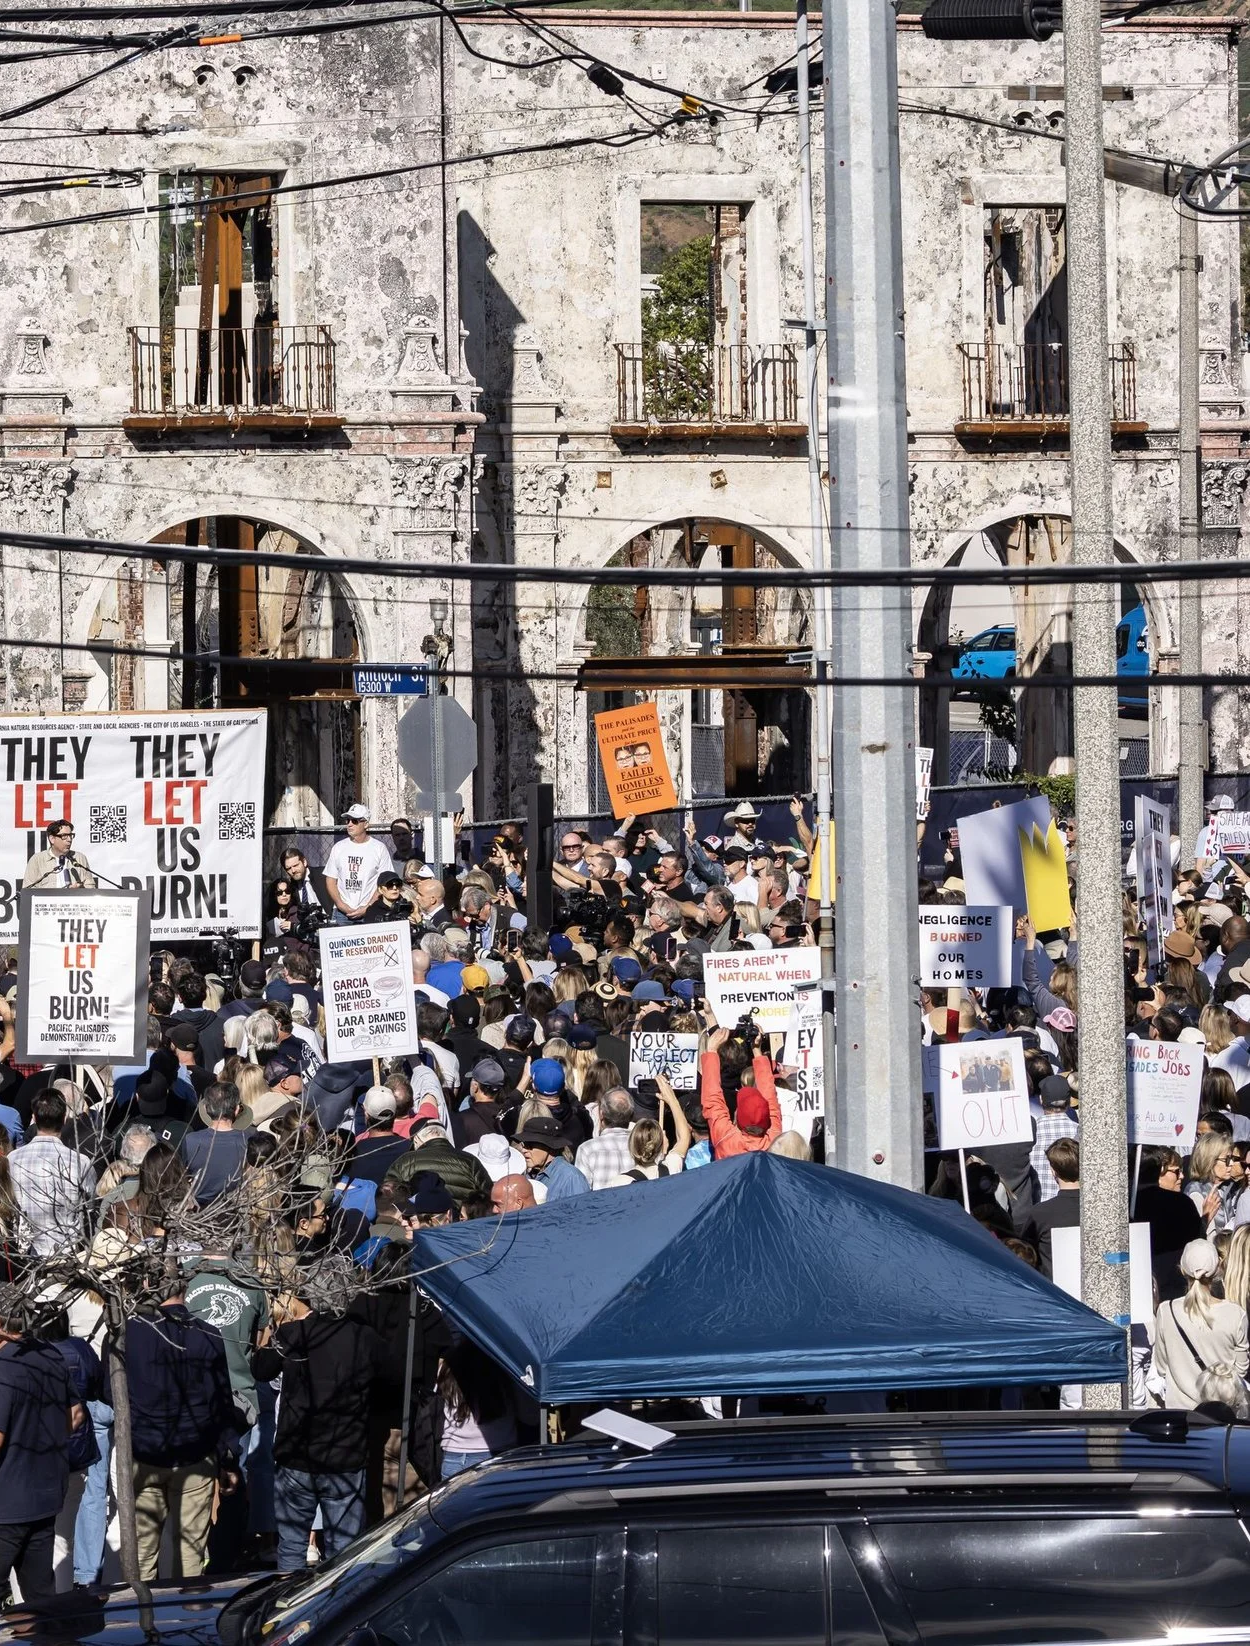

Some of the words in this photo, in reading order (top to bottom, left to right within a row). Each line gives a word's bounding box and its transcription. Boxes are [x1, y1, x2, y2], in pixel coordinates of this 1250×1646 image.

[358, 682, 382, 692] 15300
[384, 682, 392, 692] W
[600, 722, 614, 730] THE
[615, 714, 655, 728] PALISADES
[602, 732, 636, 744] ULTIMATE
[638, 727, 657, 737] PRICE
[0, 736, 92, 782] THEY
[130, 733, 220, 778] THEY
[620, 766, 654, 780] FAILED
[616, 776, 664, 792] HOMELESS
[624, 788, 661, 801] SCHEME
[14, 783, 78, 828] LET
[144, 780, 208, 825] LET
[1149, 809, 1163, 834] THEY
[1220, 812, 1240, 826] STATE
[1220, 831, 1246, 846] FAILED
[157, 826, 200, 872] US
[348, 856, 363, 864] THEY
[346, 879, 362, 888] BURN!
[918, 916, 992, 926] NEGLIGENCE
[58, 919, 107, 943] THEY
[930, 932, 982, 942] BURNED
[329, 938, 365, 949] QUIÑONES
[367, 934, 398, 944] DRAINED
[64, 944, 99, 968] LET
[330, 950, 344, 958] THE
[345, 945, 384, 956] RESERVOIR
[938, 953, 964, 963] OUR
[706, 959, 740, 968] FIRES
[69, 970, 93, 994] US
[718, 972, 772, 982] NATURAL
[776, 970, 811, 980] WHEN
[933, 970, 983, 980] HOMES
[333, 977, 369, 990] GARCIA
[335, 989, 372, 1002] DRAINED
[720, 991, 795, 1003] PREVENTION
[798, 992, 809, 1000] IS
[50, 996, 109, 1020] BURN!
[335, 1003, 354, 1012] THE
[354, 999, 381, 1010] HOSES
[337, 1015, 364, 1027] LARA
[368, 1011, 406, 1023] DRAINED
[48, 1024, 72, 1032] PACIFIC
[75, 1024, 109, 1033] PALISADES
[338, 1028, 355, 1038] OUR
[369, 1023, 406, 1035] SAVINGS
[40, 1033, 93, 1042] DEMONSTRATION
[96, 1034, 116, 1042] 1/7/26
[633, 1032, 679, 1049] YOUR
[798, 1028, 816, 1049] EY
[632, 1048, 698, 1063] NEGLECT
[1126, 1045, 1150, 1059] RING
[648, 1061, 681, 1078] WAS
[1162, 1060, 1190, 1076] JOBS
[963, 1096, 1021, 1138] OUT
[185, 1284, 215, 1303] PACIFIC
[215, 1284, 250, 1306] PALISADES
